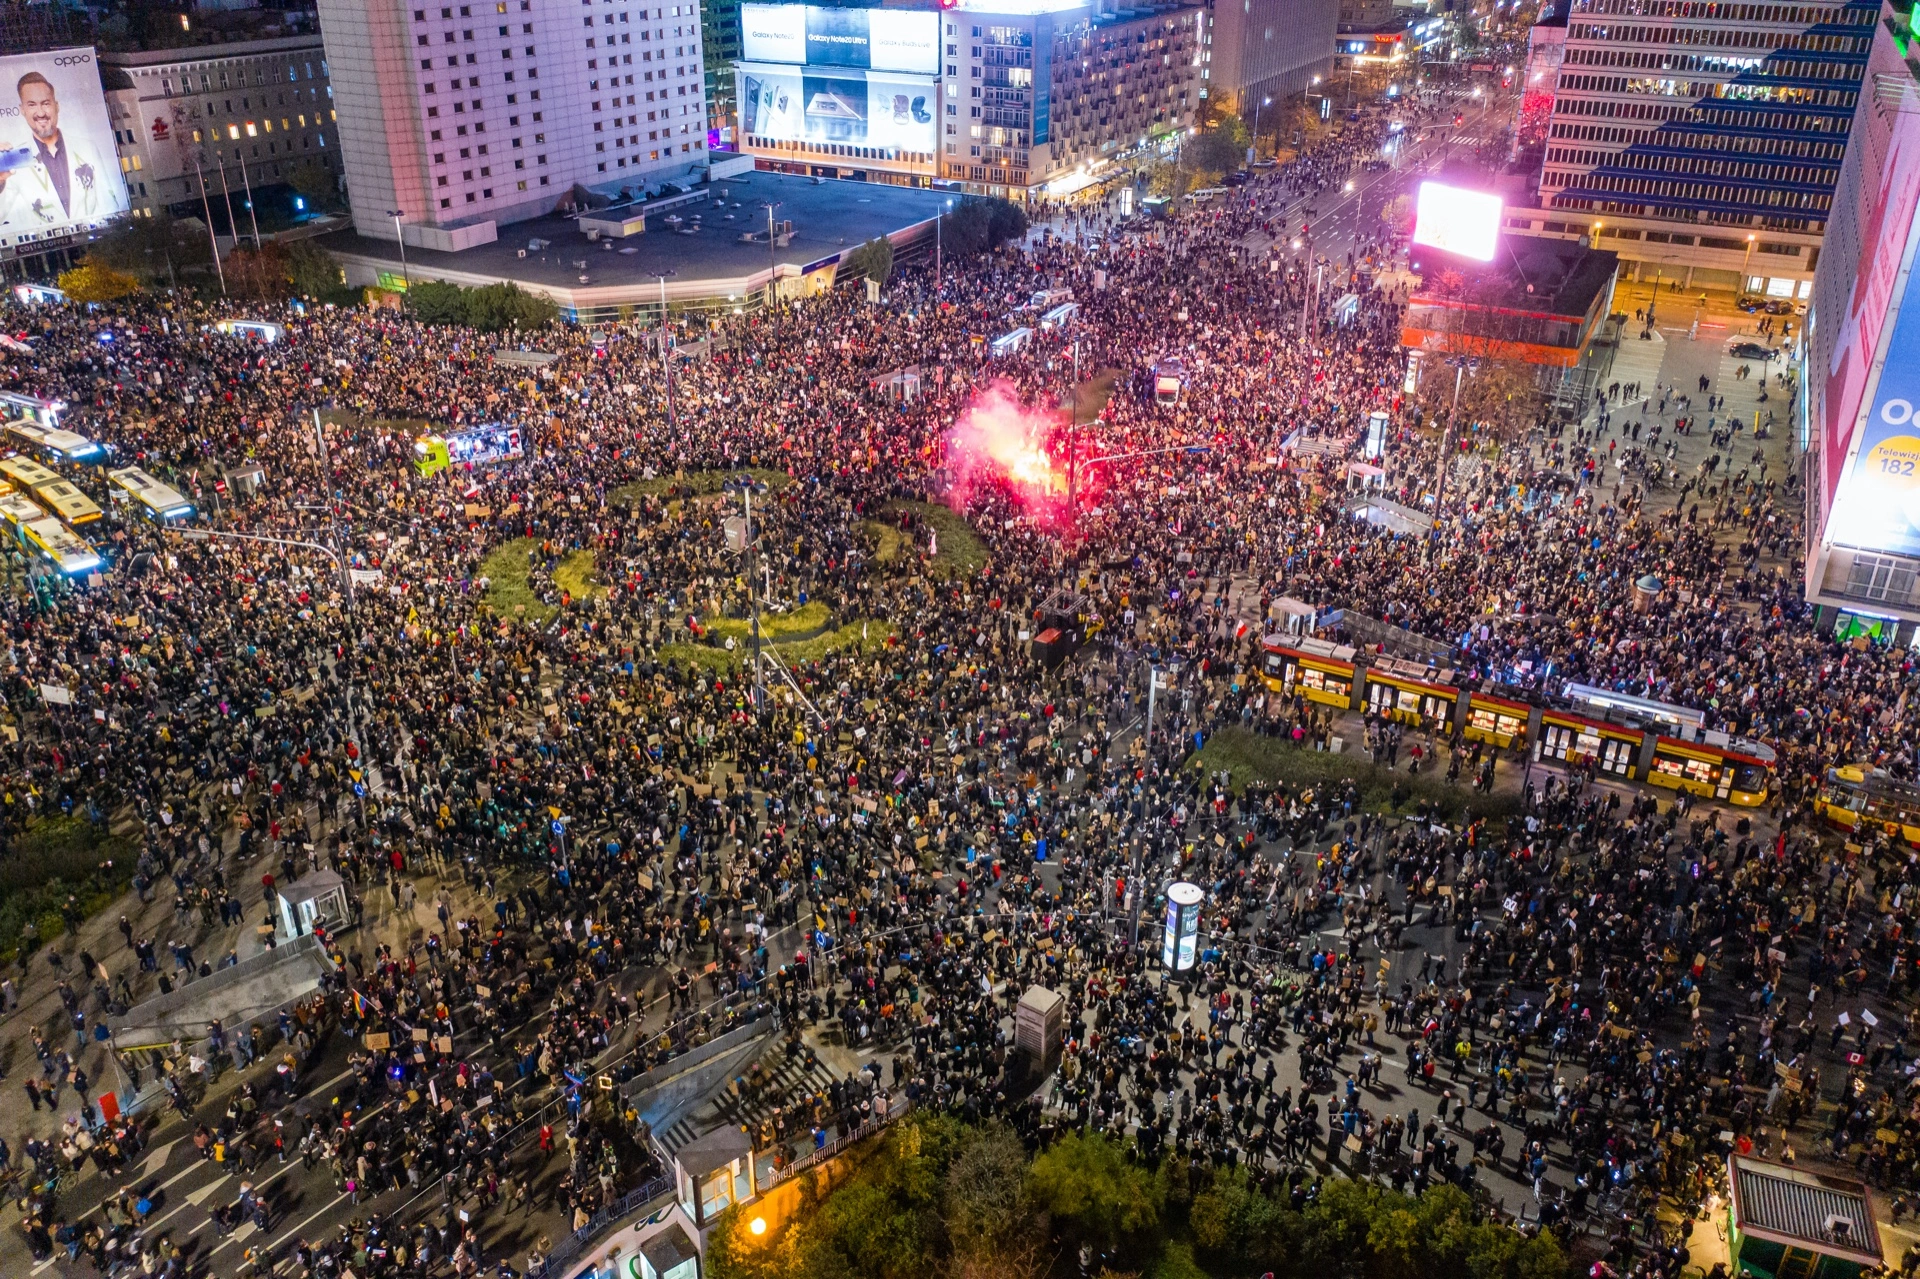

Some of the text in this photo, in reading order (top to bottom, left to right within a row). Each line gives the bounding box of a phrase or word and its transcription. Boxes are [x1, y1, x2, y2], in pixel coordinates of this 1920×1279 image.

[752, 31, 773, 39] Galaxy
[808, 34, 830, 43] Galaxy
[831, 35, 852, 44] Note20
[54, 55, 90, 67] oppo
[0, 107, 19, 117] PRO
[20, 237, 69, 252] COSTA COFFEE
[1879, 447, 1920, 461] Telewizj
[1881, 458, 1915, 476] 182
